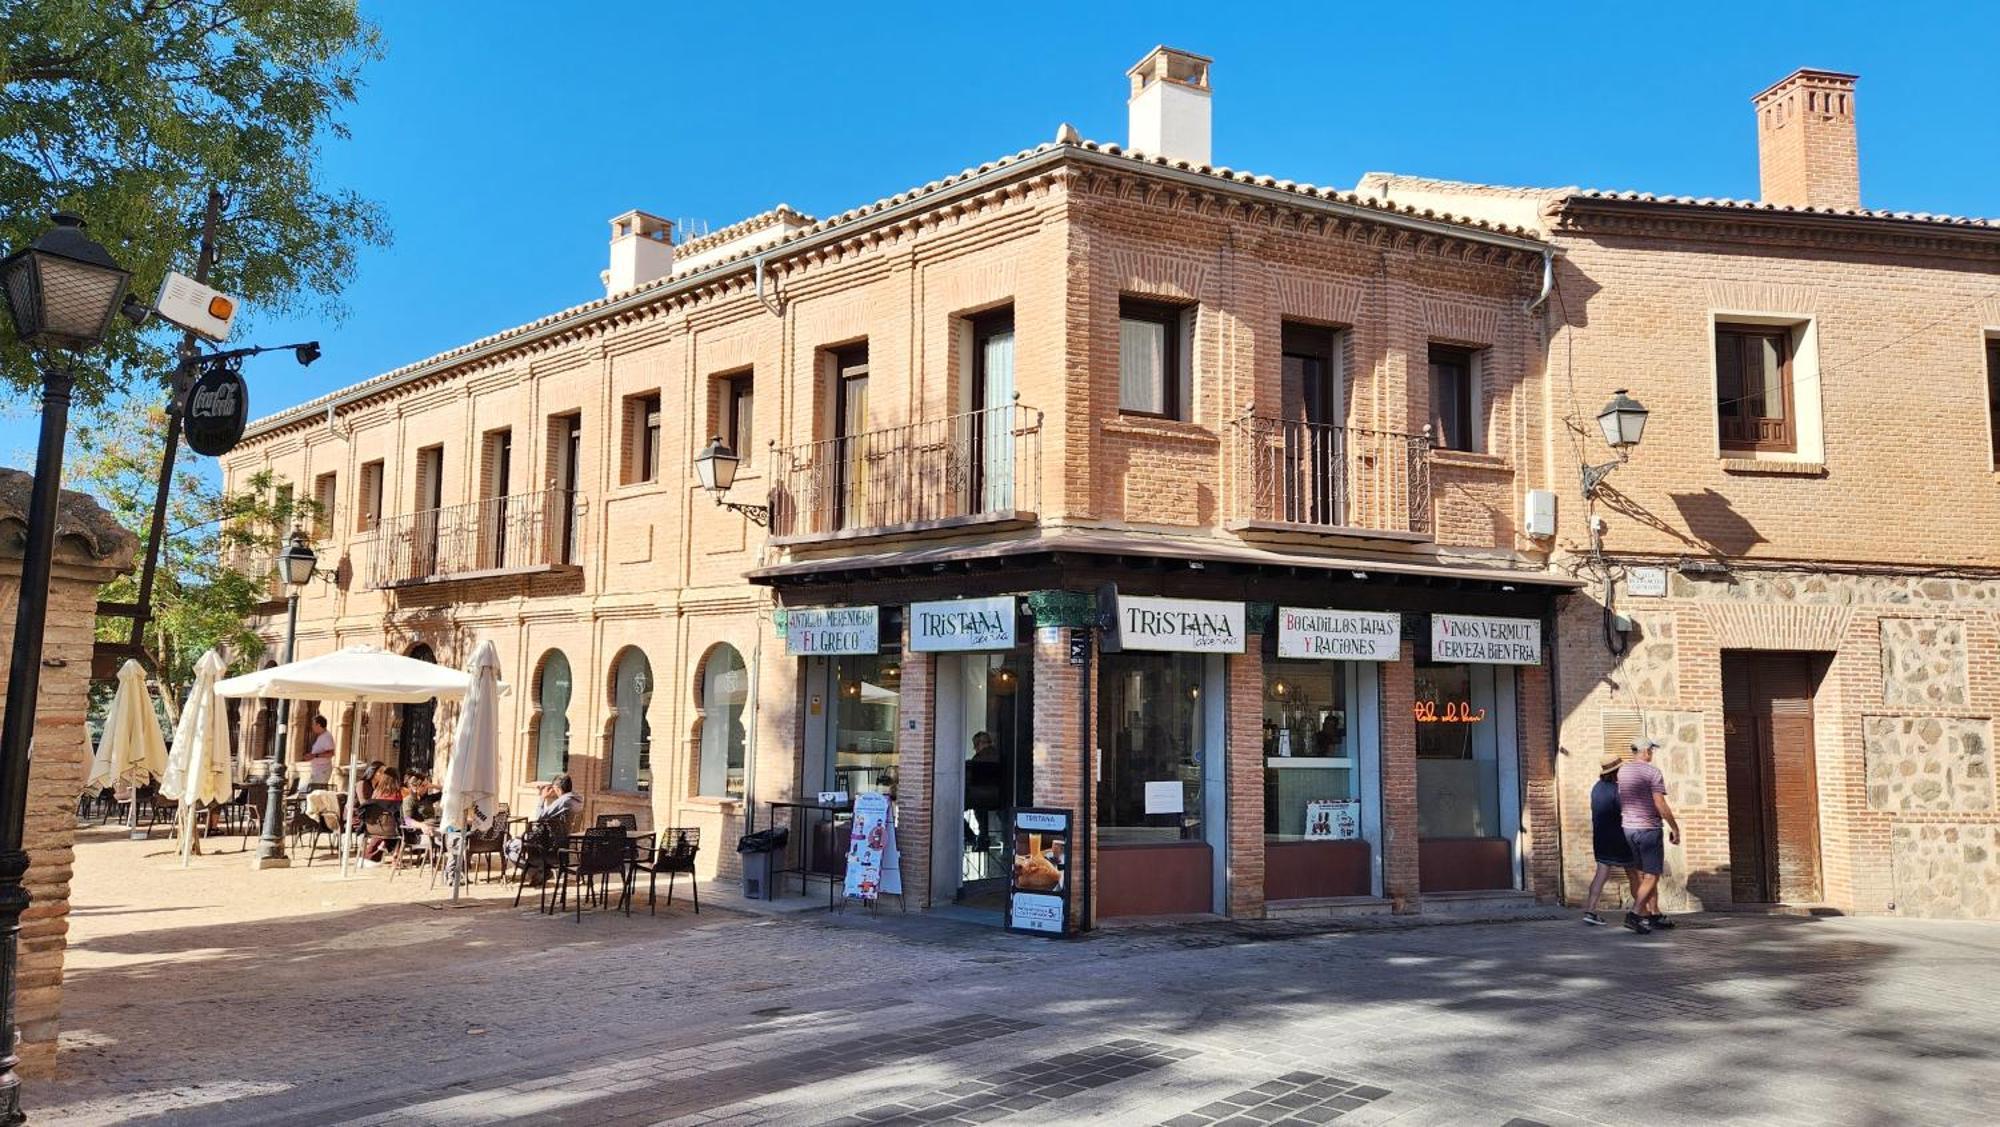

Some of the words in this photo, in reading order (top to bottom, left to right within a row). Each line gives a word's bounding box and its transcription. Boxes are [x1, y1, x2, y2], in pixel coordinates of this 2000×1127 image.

[1360, 617, 1394, 636] TAPAS
[1304, 637, 1312, 652] Y
[1438, 640, 1486, 659] CERVEZA
